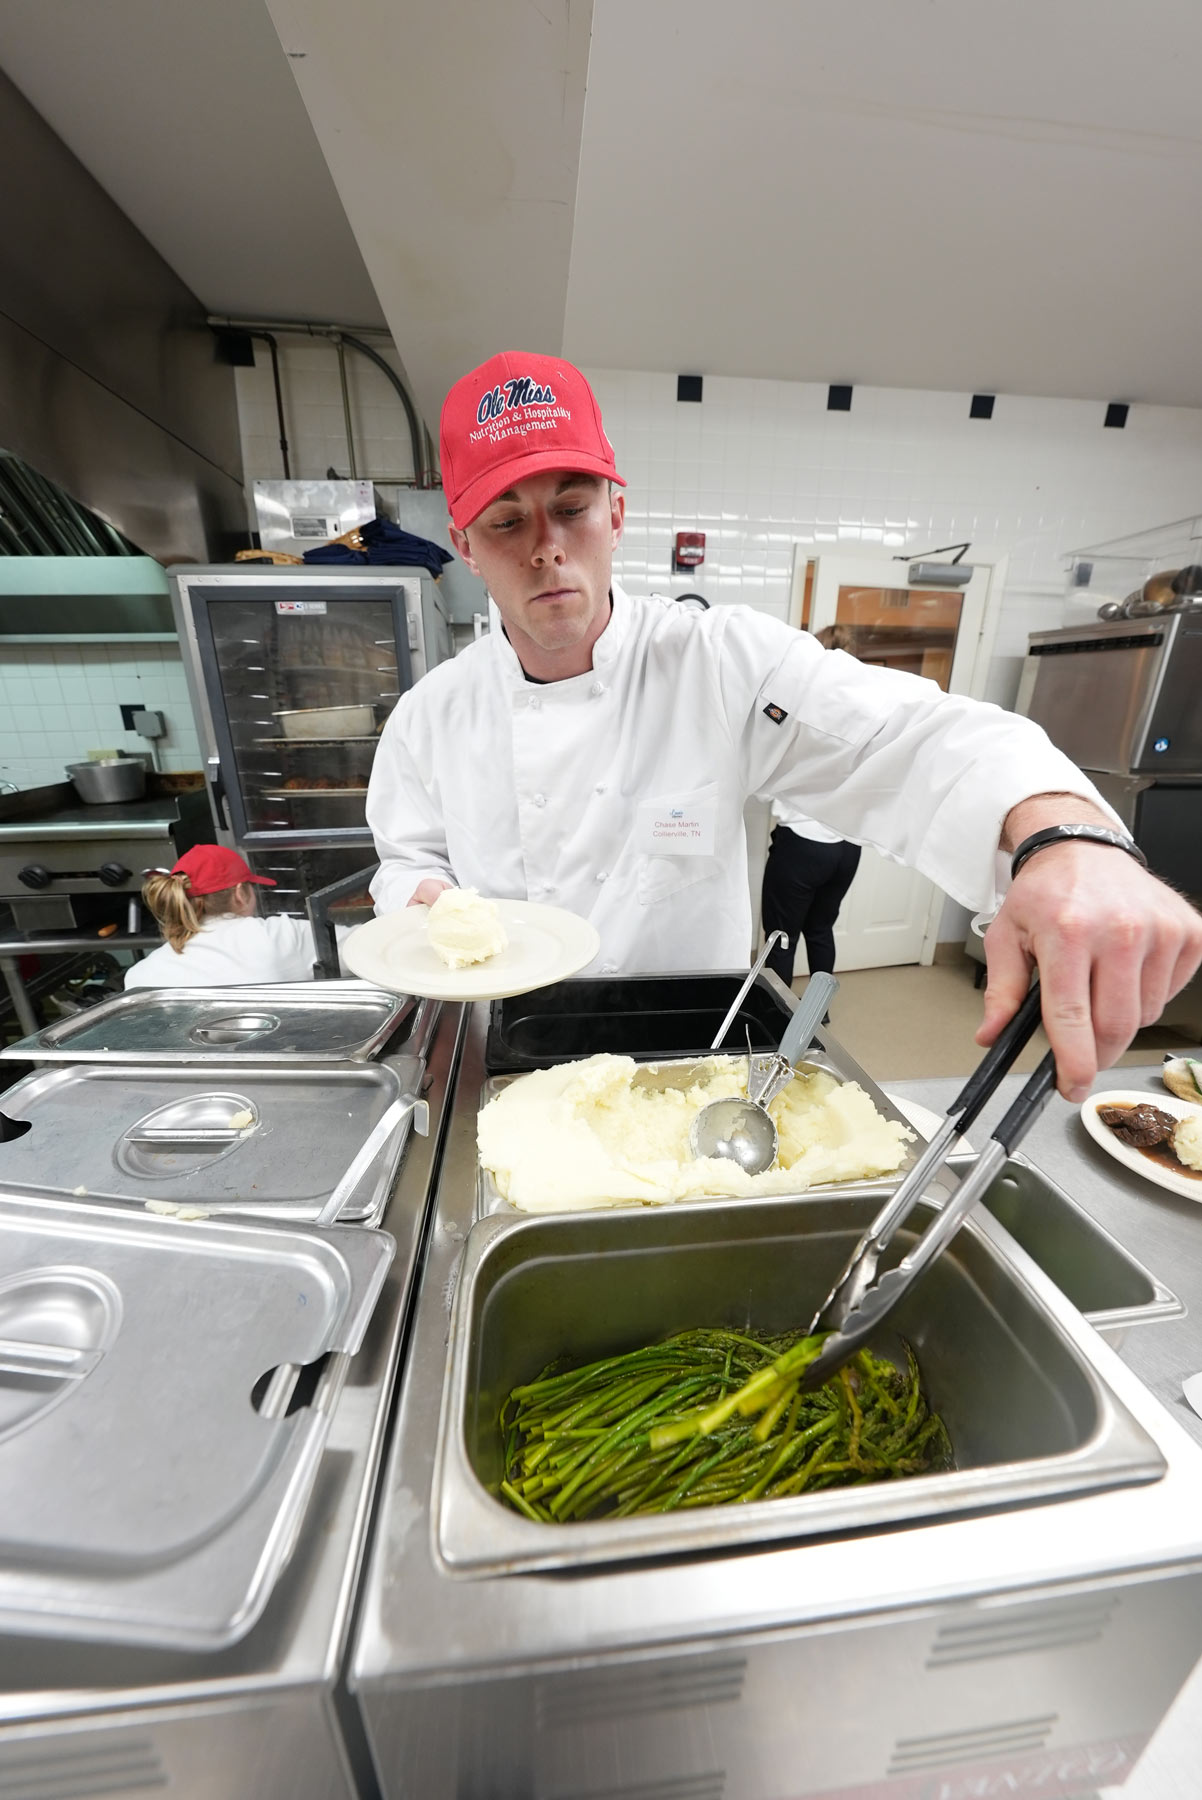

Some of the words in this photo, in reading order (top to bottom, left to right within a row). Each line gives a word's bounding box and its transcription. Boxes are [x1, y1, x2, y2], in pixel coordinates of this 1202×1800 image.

[477, 385, 505, 425] Ole
[504, 376, 556, 410] Miss
[469, 415, 510, 444] Nutrition
[512, 411, 522, 422] &
[524, 406, 571, 421] Hospitality
[489, 419, 557, 444] Management
[653, 830, 689, 838] Collierville,
